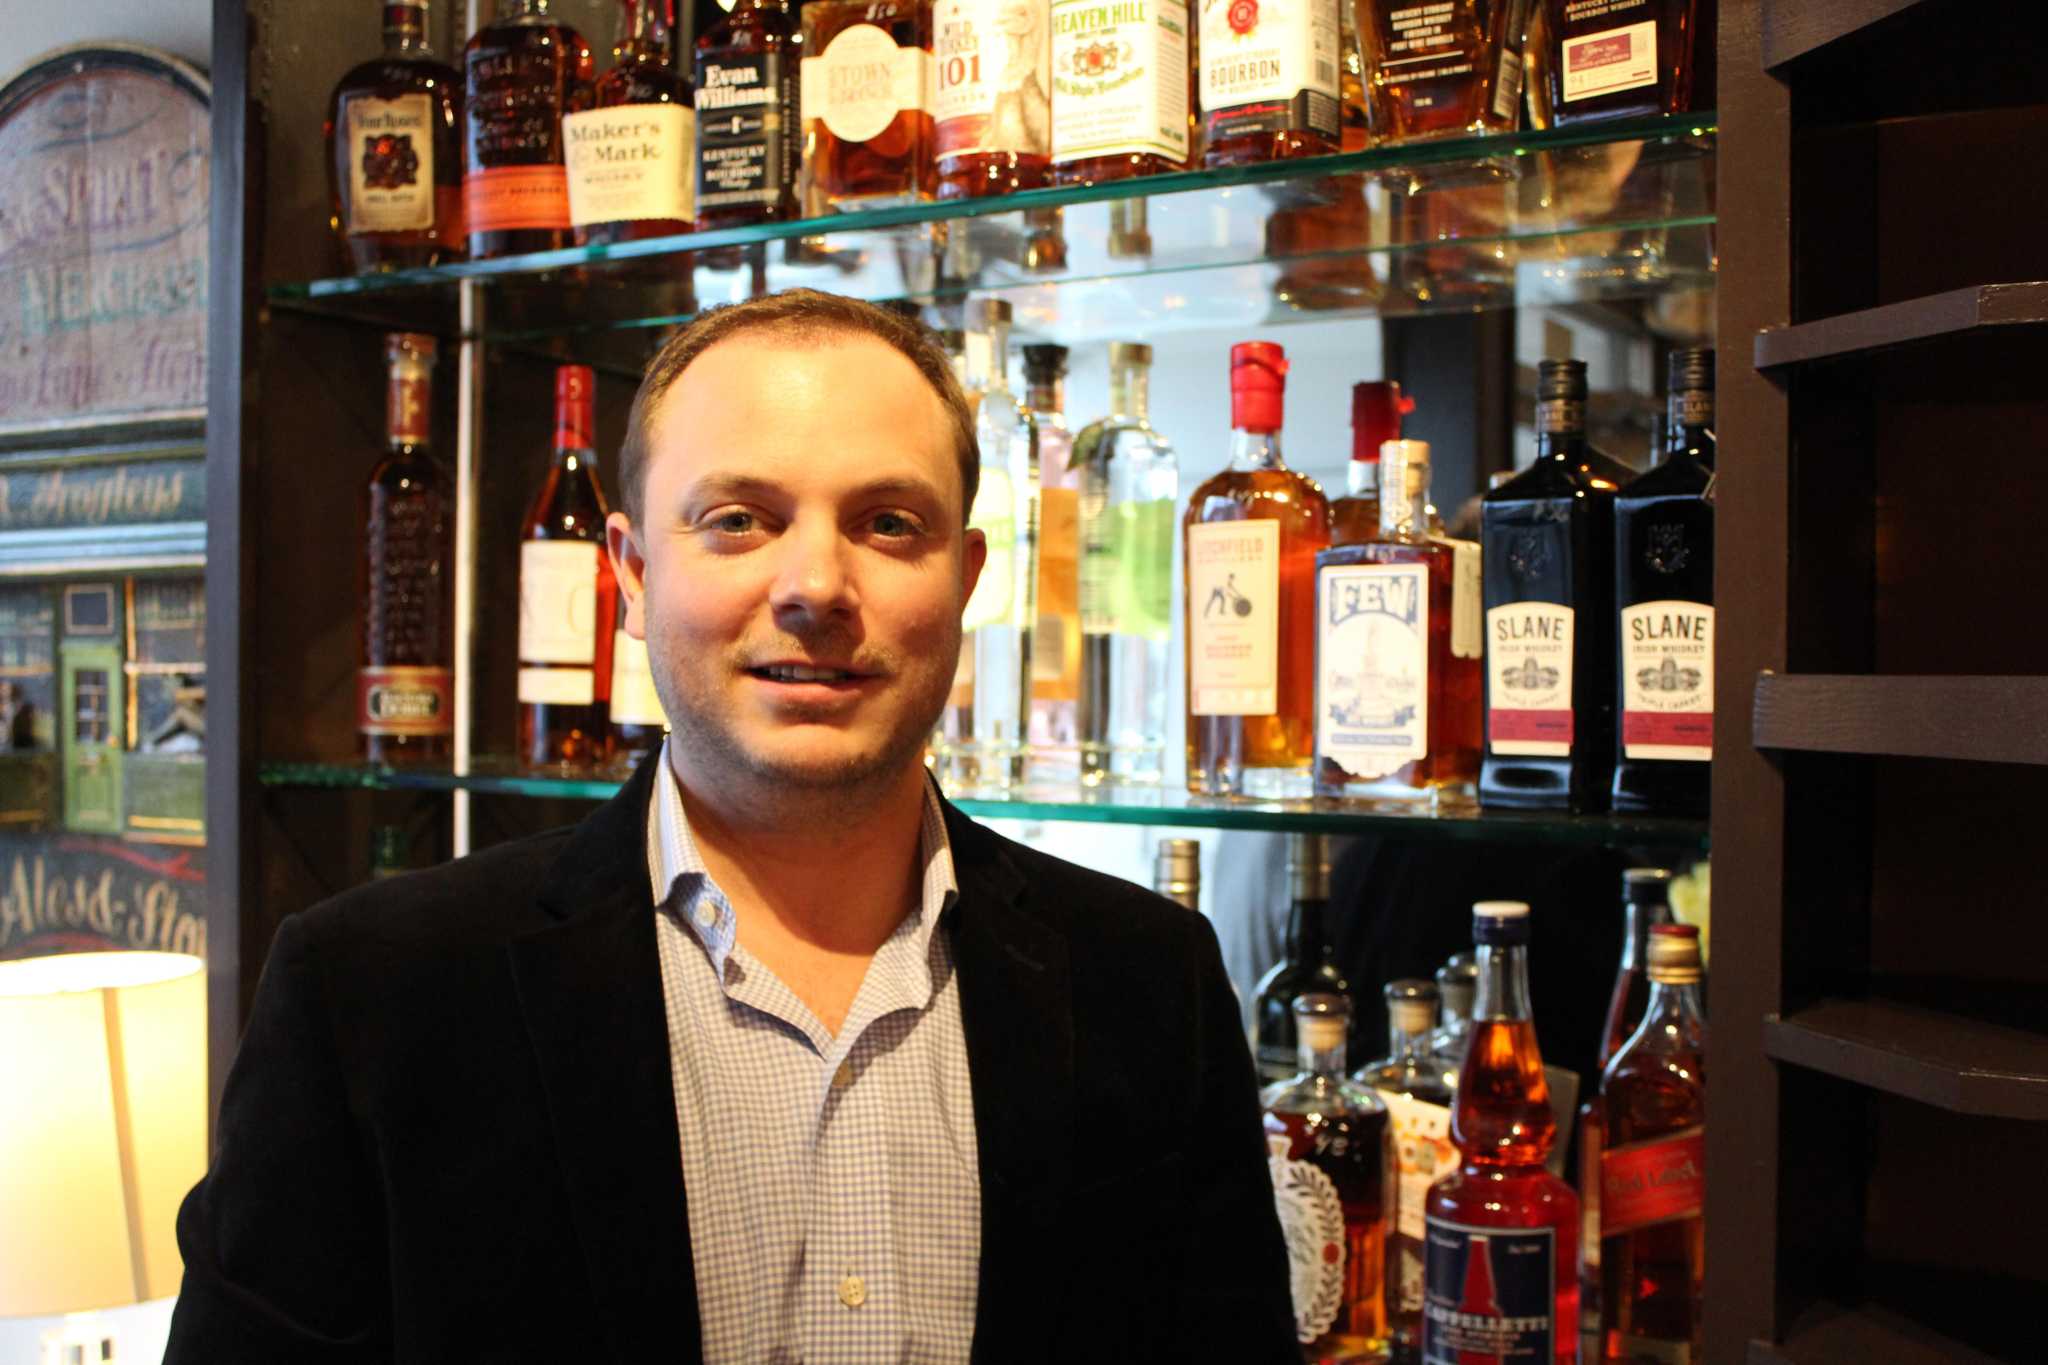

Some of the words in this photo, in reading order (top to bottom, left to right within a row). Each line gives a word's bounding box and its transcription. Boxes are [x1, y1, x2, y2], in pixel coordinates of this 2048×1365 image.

[1054, 8, 1107, 34] HEAVEN
[1112, 1, 1146, 26] HILL
[705, 65, 759, 88] Evan
[938, 54, 980, 91] 101
[1210, 59, 1281, 88] BOURBON
[694, 86, 779, 111] Williams
[571, 120, 662, 143] Maker's
[595, 143, 661, 162] Mark
[1332, 577, 1418, 623] FEW
[1497, 617, 1565, 643] SLANE
[1632, 615, 1707, 643] SLANE
